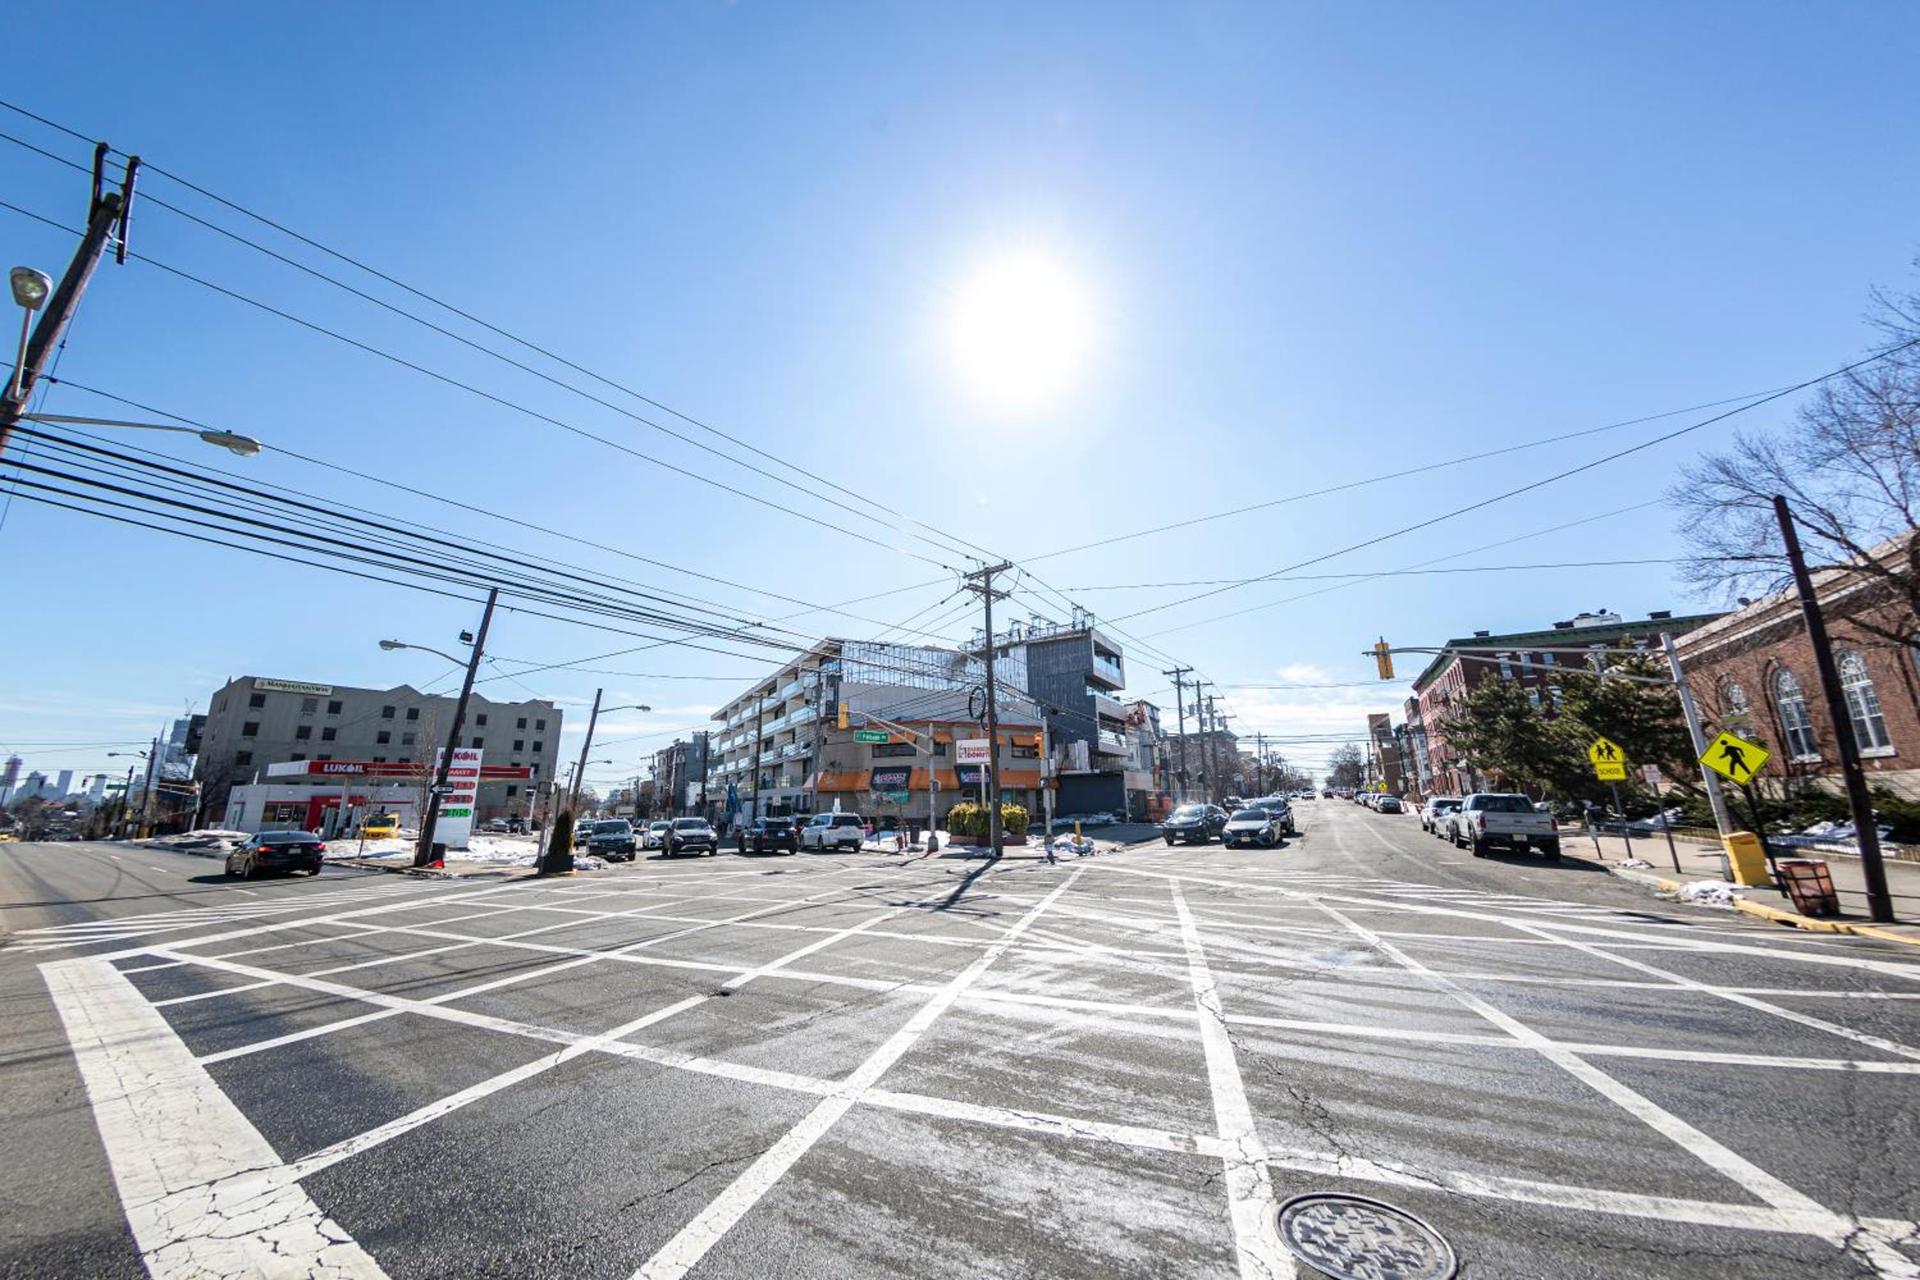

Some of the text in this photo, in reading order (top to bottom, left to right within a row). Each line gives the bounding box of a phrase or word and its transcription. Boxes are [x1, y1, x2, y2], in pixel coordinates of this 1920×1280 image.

[440, 751, 479, 760] LKOIL
[323, 763, 364, 773] LUKOIL
[1599, 767, 1620, 775] SCHOOL
